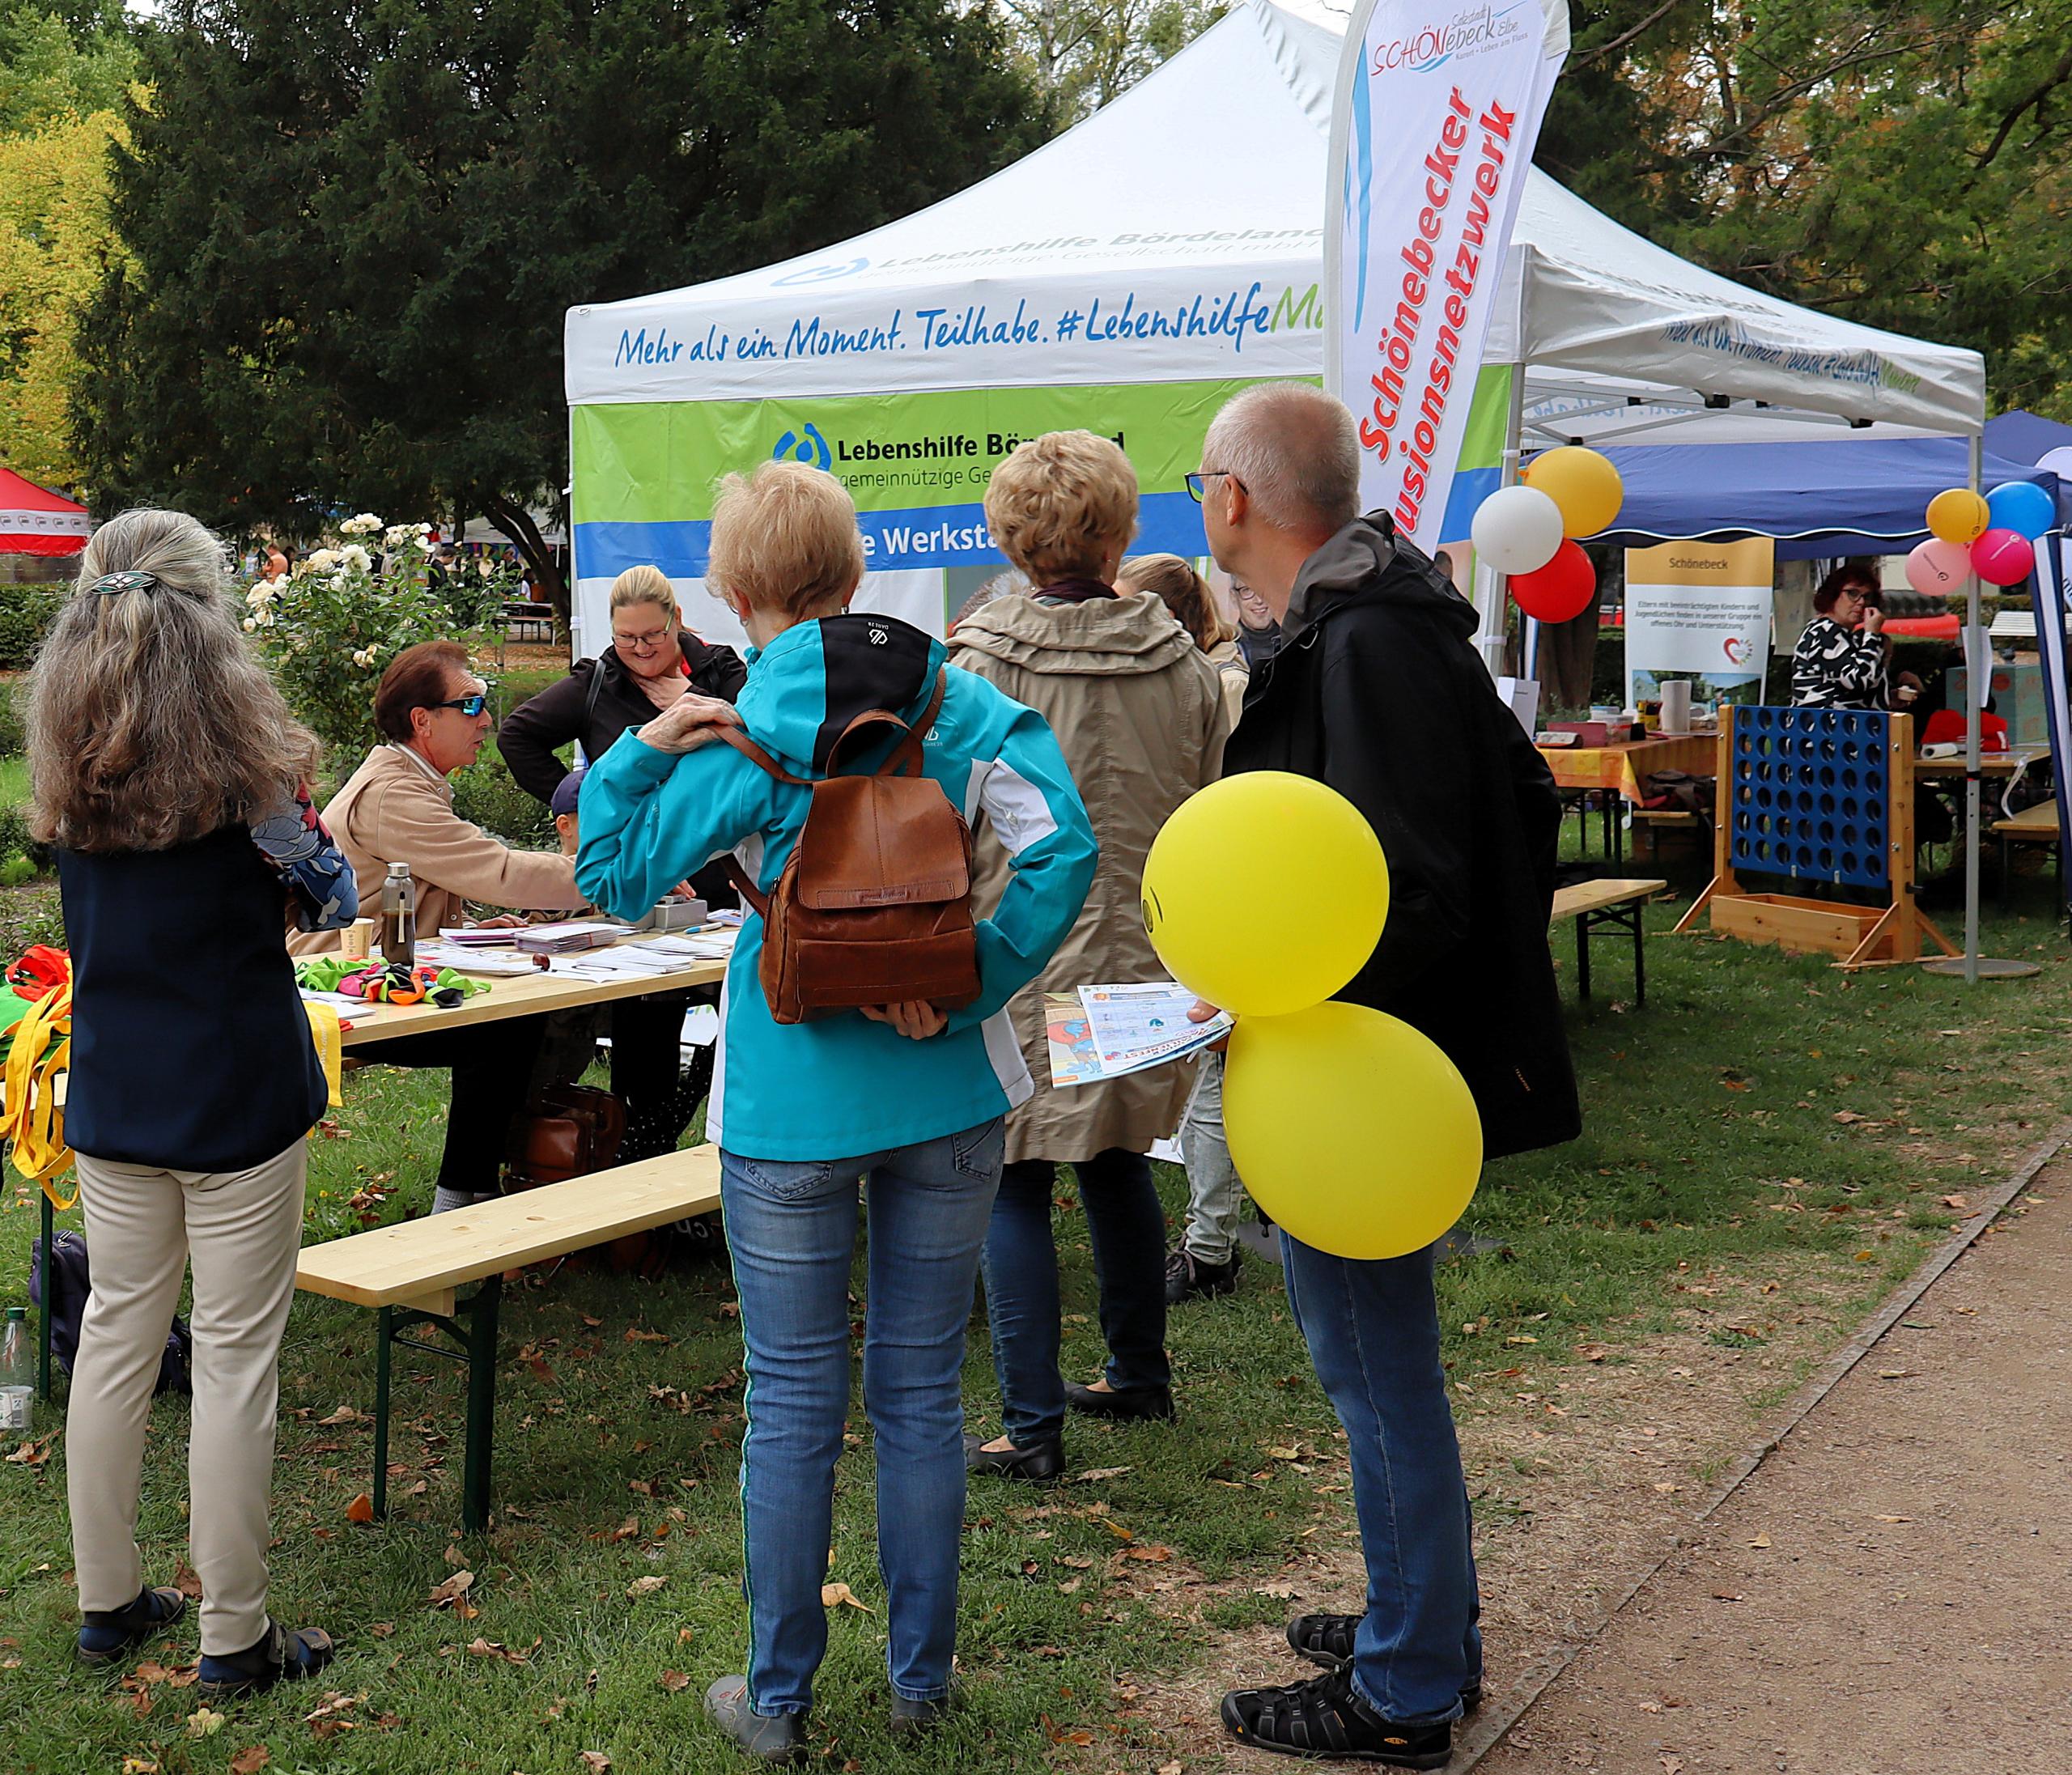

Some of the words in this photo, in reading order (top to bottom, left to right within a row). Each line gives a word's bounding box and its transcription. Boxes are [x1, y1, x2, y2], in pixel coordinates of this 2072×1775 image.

[1480, 42, 1499, 53] Leben
[1512, 32, 1529, 44] Fluss
[1360, 84, 1473, 464] Schönebecker
[615, 328, 682, 368] Mehr
[690, 325, 727, 362] als
[737, 332, 777, 360] ein
[783, 309, 906, 360] Moment.
[916, 299, 1049, 350] Teilhabe.
[838, 435, 978, 461] Lebenshilfe
[840, 469, 963, 491] gemeinnützige
[1669, 558, 1728, 569] Schönebeck
